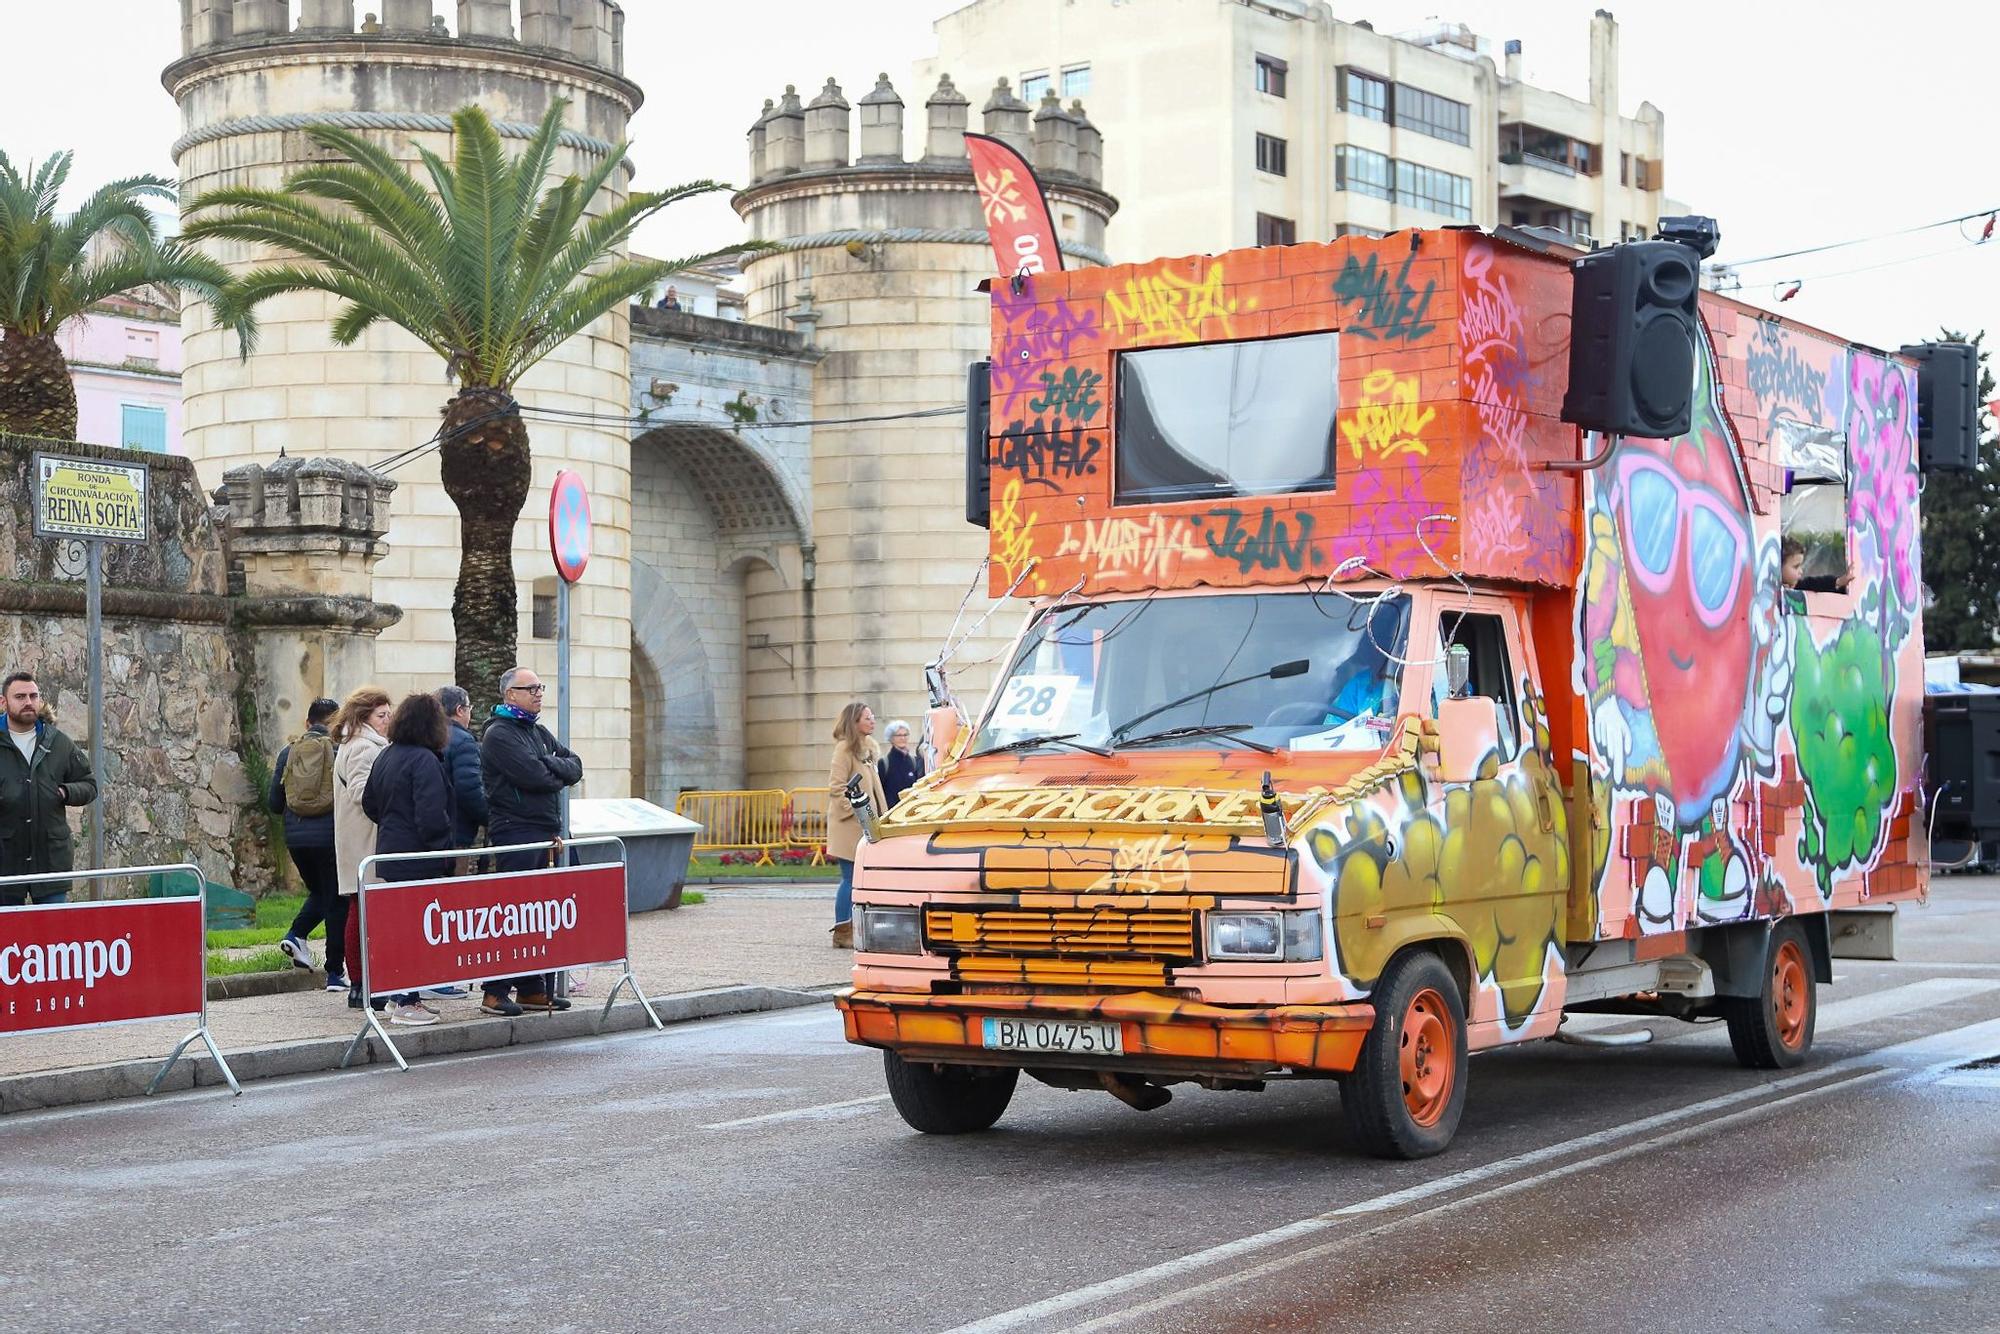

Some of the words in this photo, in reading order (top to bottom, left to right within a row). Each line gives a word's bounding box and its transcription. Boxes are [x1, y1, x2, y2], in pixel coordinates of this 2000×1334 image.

[1105, 262, 1236, 340] MARTA
[50, 486, 133, 502] CIRCUNVALACIÓN
[77, 473, 111, 485] RONDA
[47, 497, 91, 524] REINA
[96, 502, 138, 528] SOFÍA
[1008, 686, 1057, 716] 28
[423, 897, 578, 946] Cruzcampo
[457, 950, 501, 967] DESDE
[513, 944, 546, 960] 1904
[35, 994, 85, 1013] 1904
[1000, 1022, 1029, 1049] BA
[1036, 1023, 1095, 1050] 0475
[1101, 1026, 1116, 1052] U
